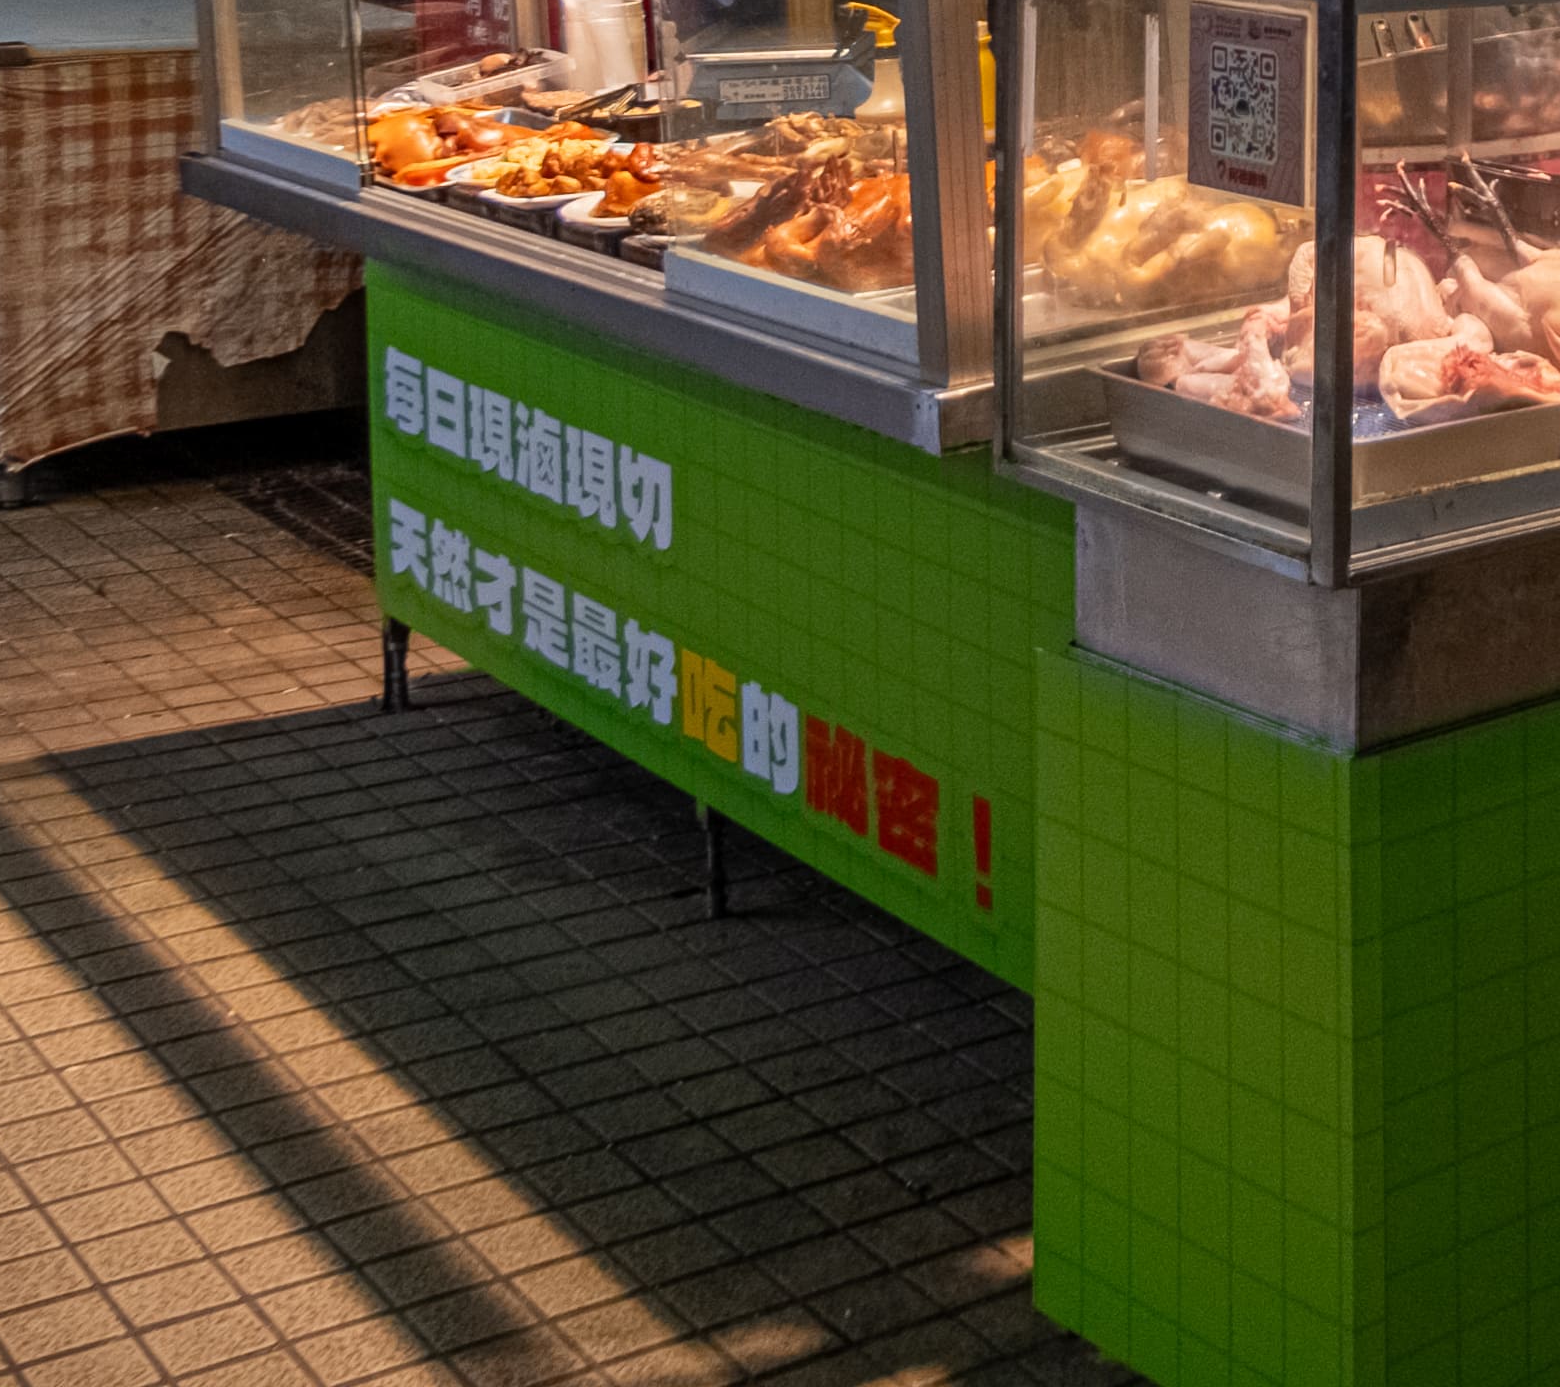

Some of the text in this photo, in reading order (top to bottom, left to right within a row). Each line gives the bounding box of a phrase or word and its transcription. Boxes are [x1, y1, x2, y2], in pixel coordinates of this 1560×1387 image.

[384, 346, 673, 551] 每日現滷現切
